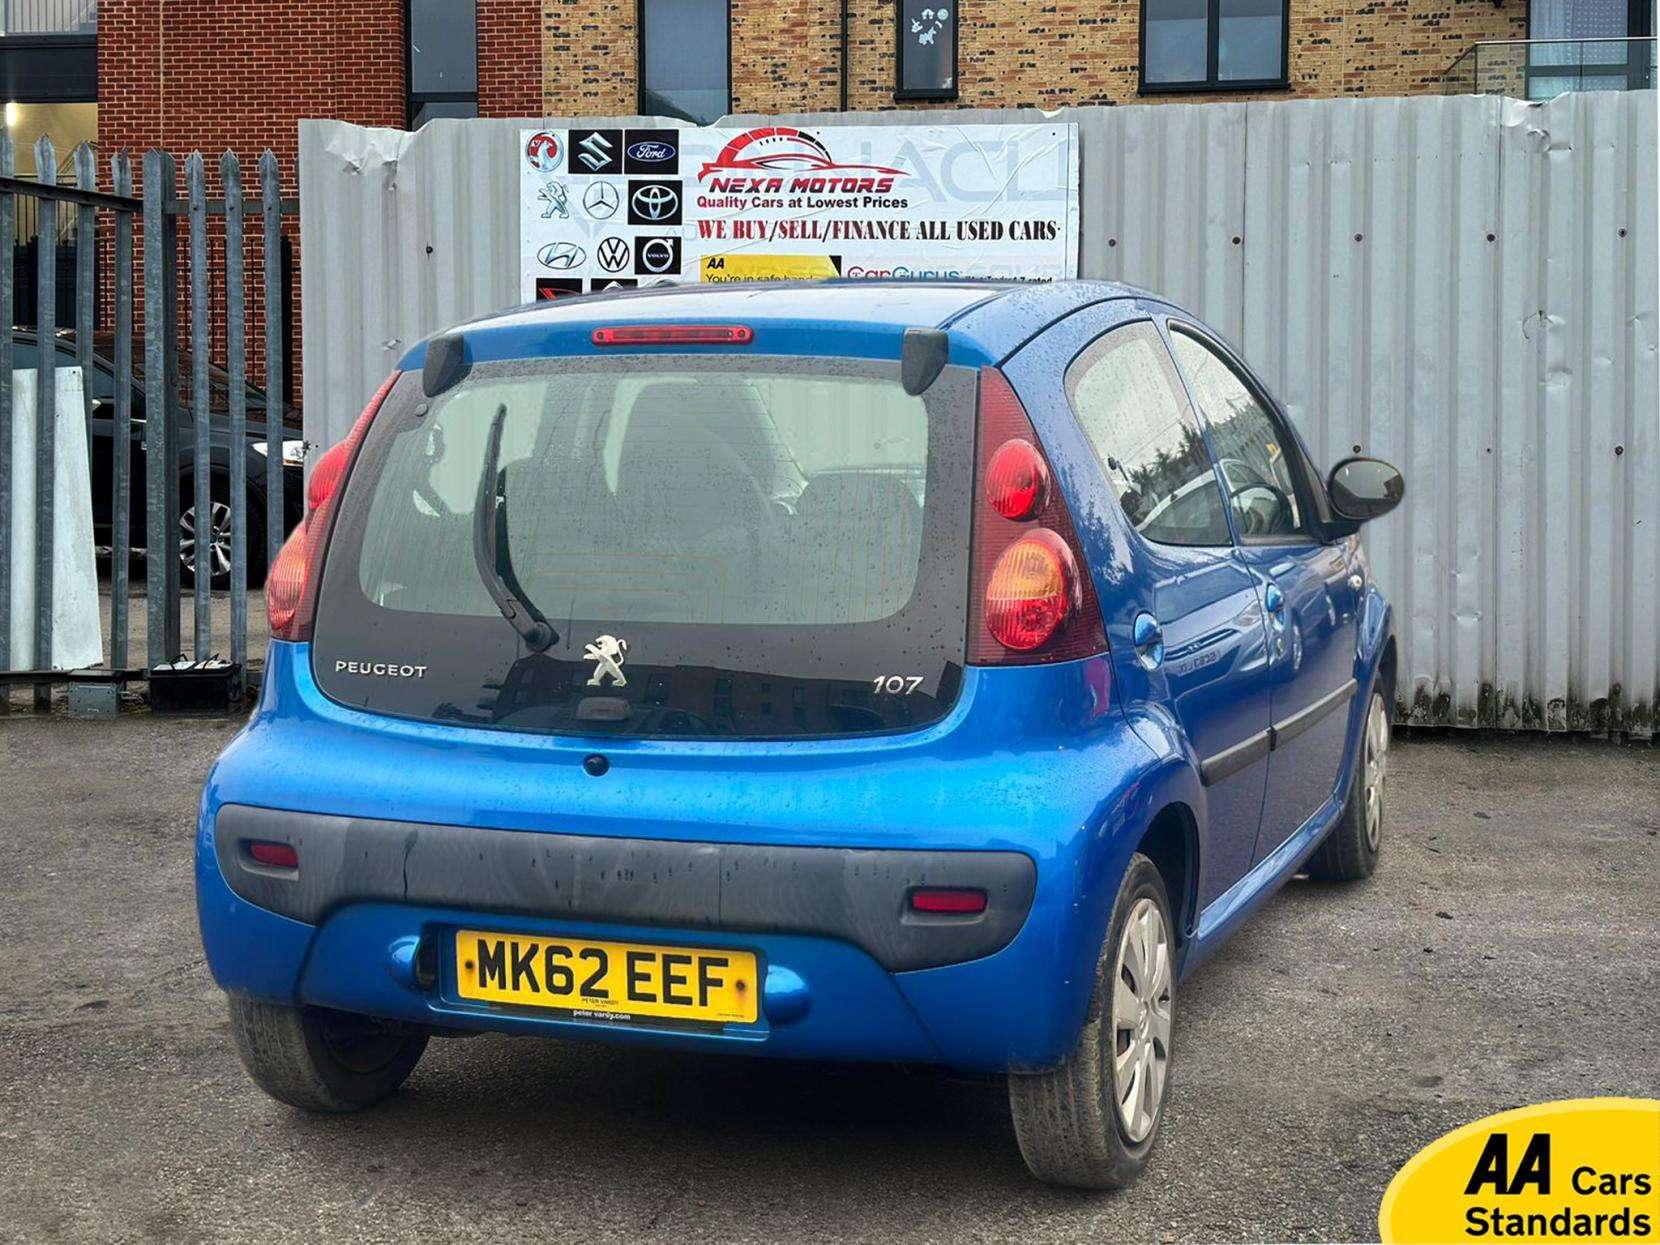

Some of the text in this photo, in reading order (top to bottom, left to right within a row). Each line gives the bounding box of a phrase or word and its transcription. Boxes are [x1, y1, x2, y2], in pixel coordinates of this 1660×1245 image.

[636, 144, 665, 158] Ford
[709, 178, 894, 193] NEXA MOTORS
[697, 197, 908, 210] Quality Cars at Lowest Prices
[697, 220, 726, 239] WE
[733, 220, 910, 242] BUY/SELL/FINANCE
[916, 221, 950, 240] ALL
[957, 221, 1003, 240] USED
[706, 257, 725, 269] AA
[335, 660, 427, 677] PEUGEOT
[873, 675, 924, 695] 107
[477, 938, 729, 1006] MK62 EEF
